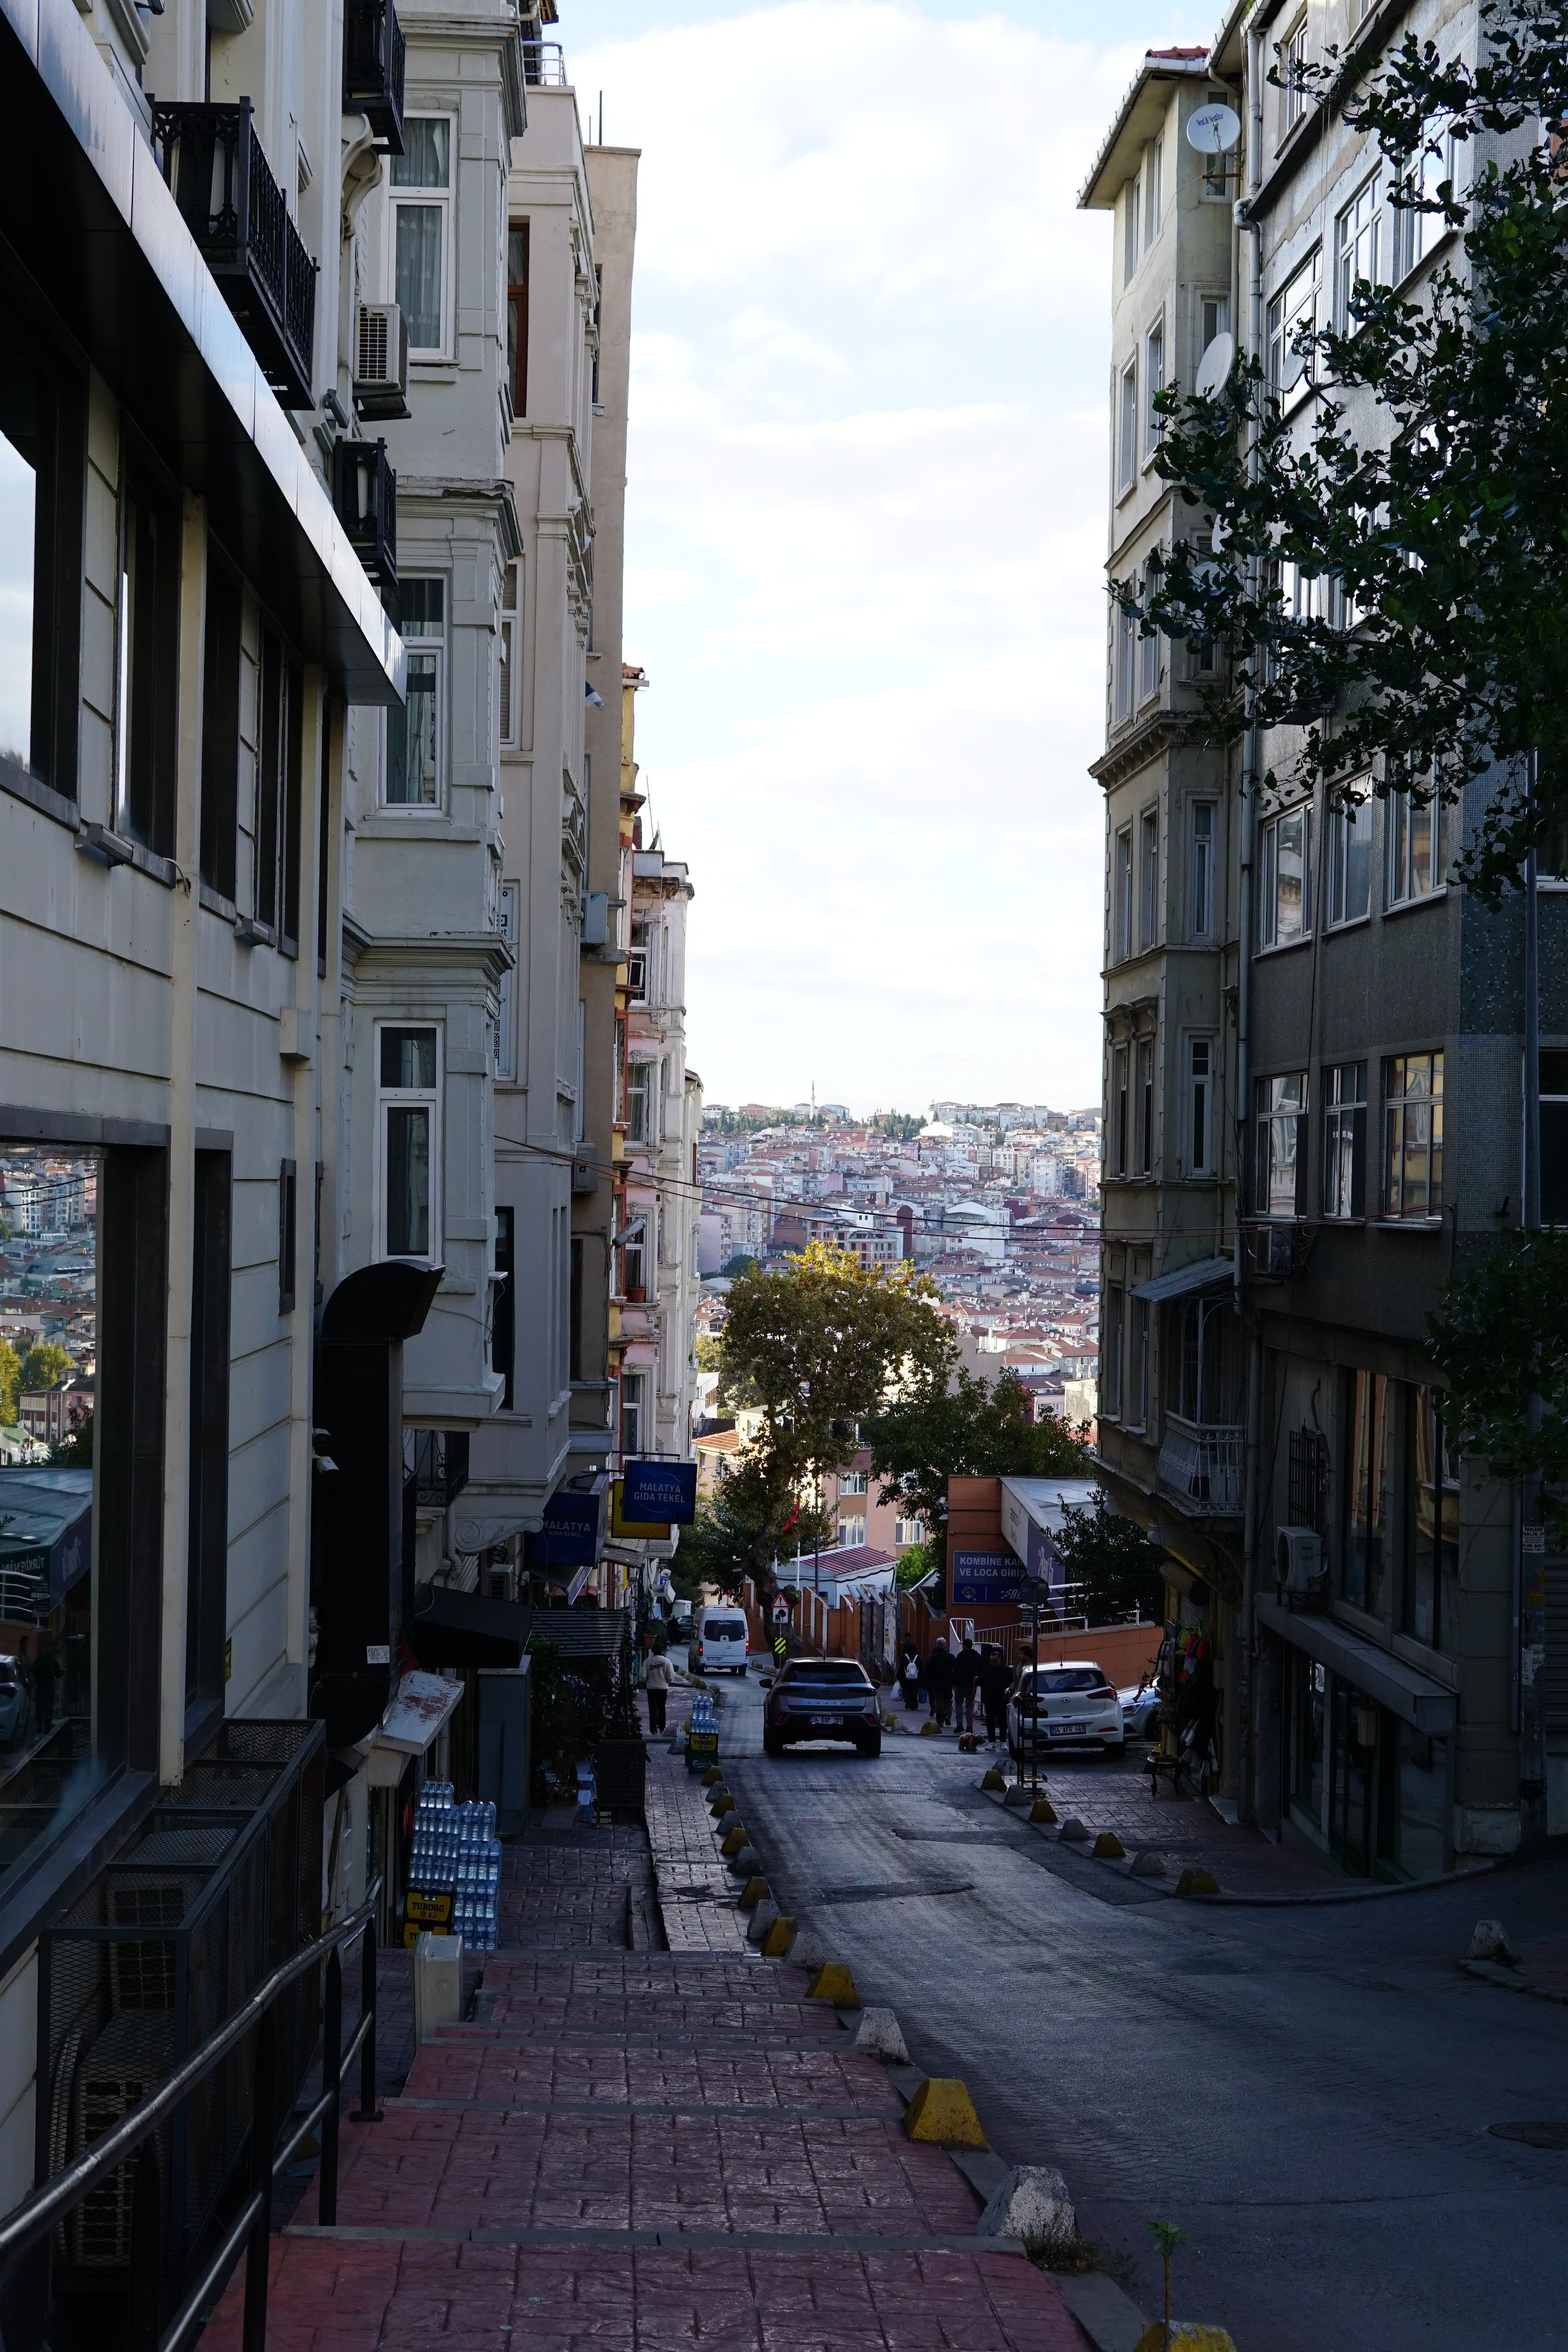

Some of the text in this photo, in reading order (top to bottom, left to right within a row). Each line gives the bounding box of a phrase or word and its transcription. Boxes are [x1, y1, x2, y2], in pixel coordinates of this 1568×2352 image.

[639, 1482, 680, 1493] MALATYA
[634, 1492, 685, 1503] GIDA TEKEL
[960, 1556, 1023, 1566] KOMBİNE KAR
[974, 1568, 998, 1577] LOCA
[412, 1902, 445, 1913] TUBORG
